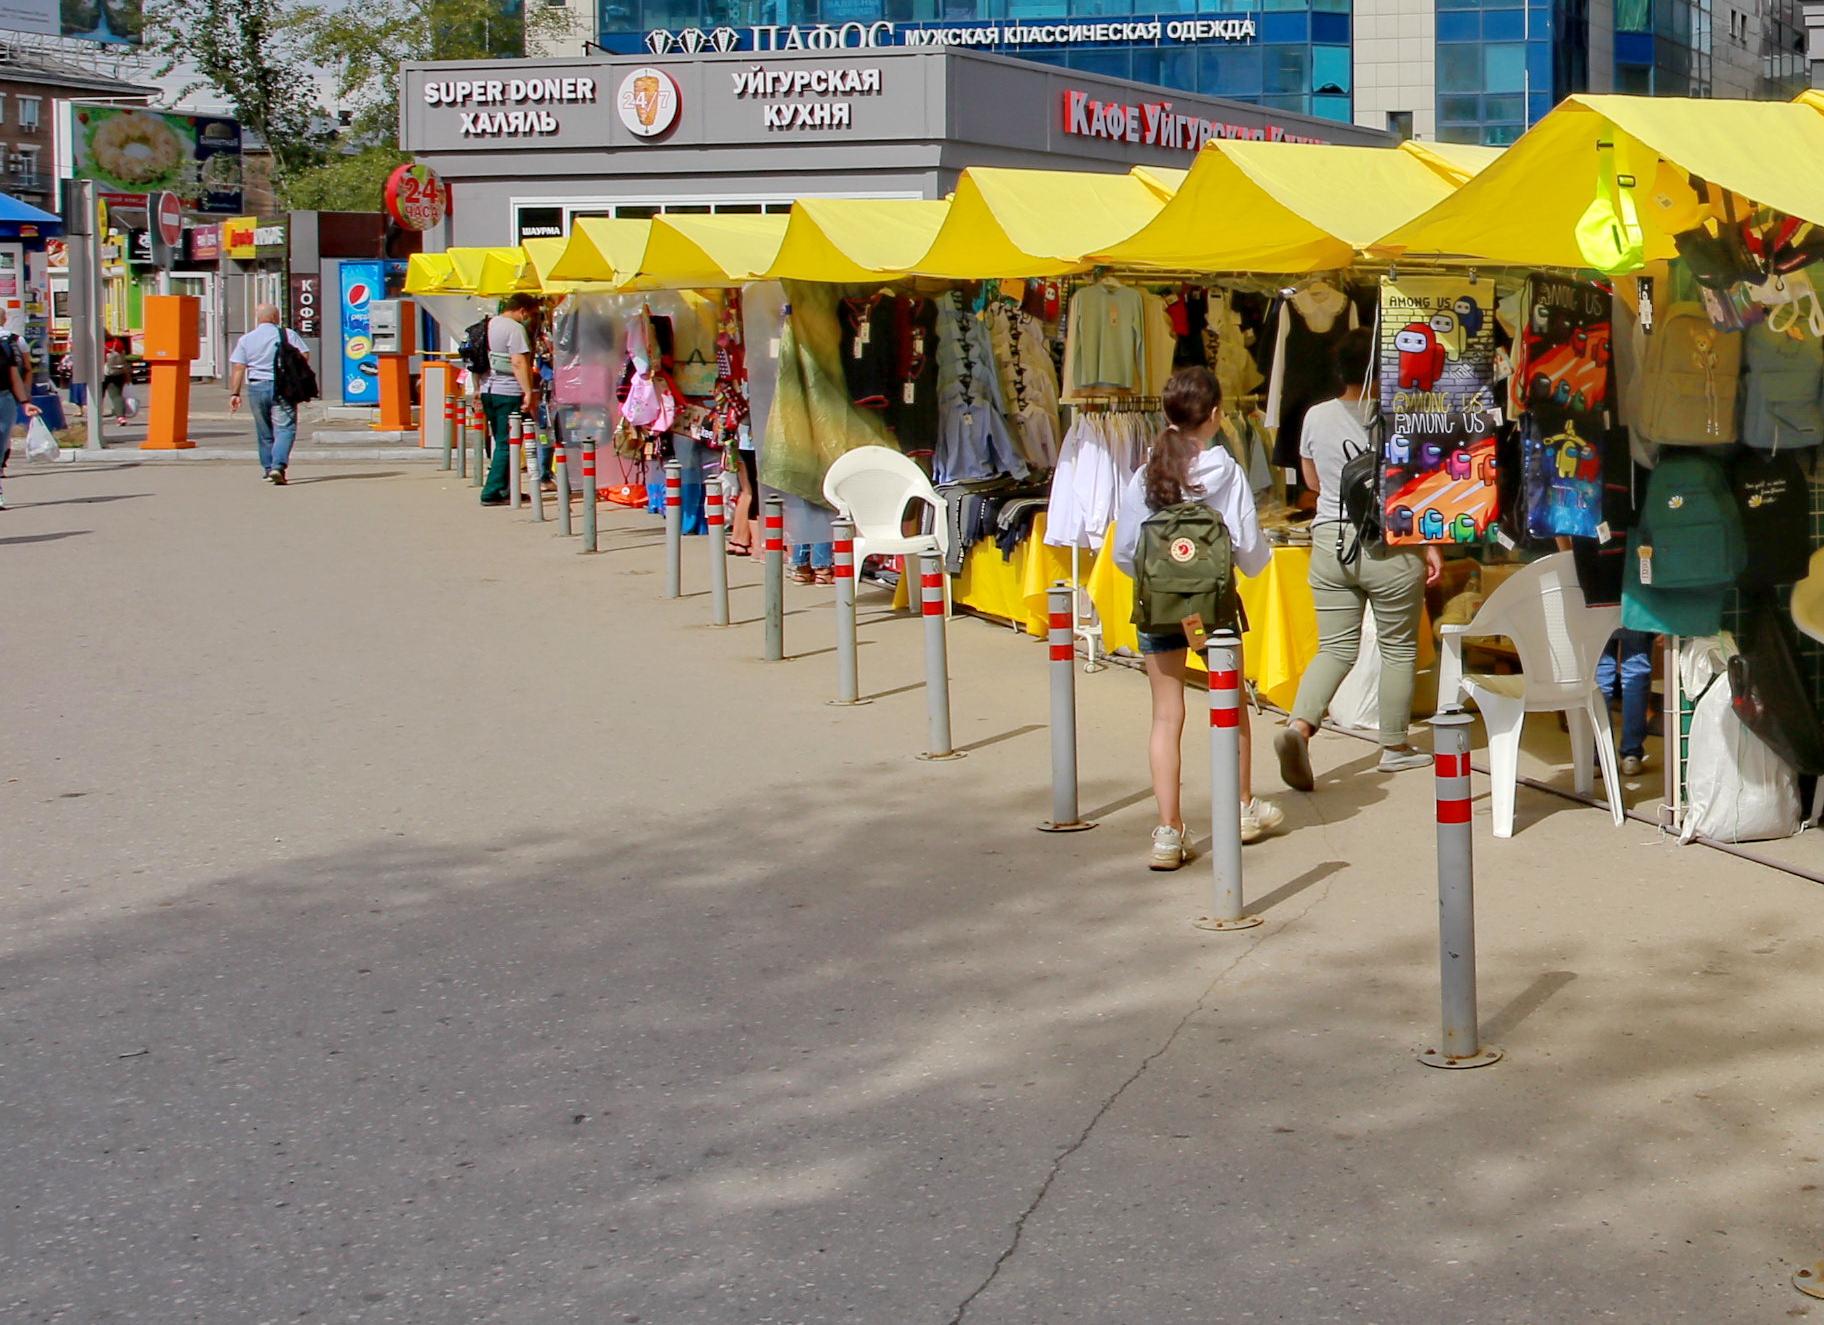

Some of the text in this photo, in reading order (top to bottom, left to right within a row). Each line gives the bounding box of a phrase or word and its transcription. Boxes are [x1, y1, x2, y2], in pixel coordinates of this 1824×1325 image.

[751, 20, 896, 51] ПАФОС
[904, 19, 1256, 47] МУЖСКАЯ КЛАССИЧЕСКАЯ ОДЕЖДА
[424, 77, 595, 104] SUPER DONER
[731, 65, 882, 95] УЙГУРСКАЯ
[622, 91, 673, 112] 24/7
[460, 111, 558, 134] ХАЛЯЛЬ
[763, 102, 851, 127] КУХНЯ
[404, 205, 439, 218] ЧАСА
[521, 226, 561, 236] ШАУРМА
[299, 279, 315, 332] КОФЕ
[1389, 296, 1451, 308] AMONG US
[1395, 413, 1484, 434] AMONG US
